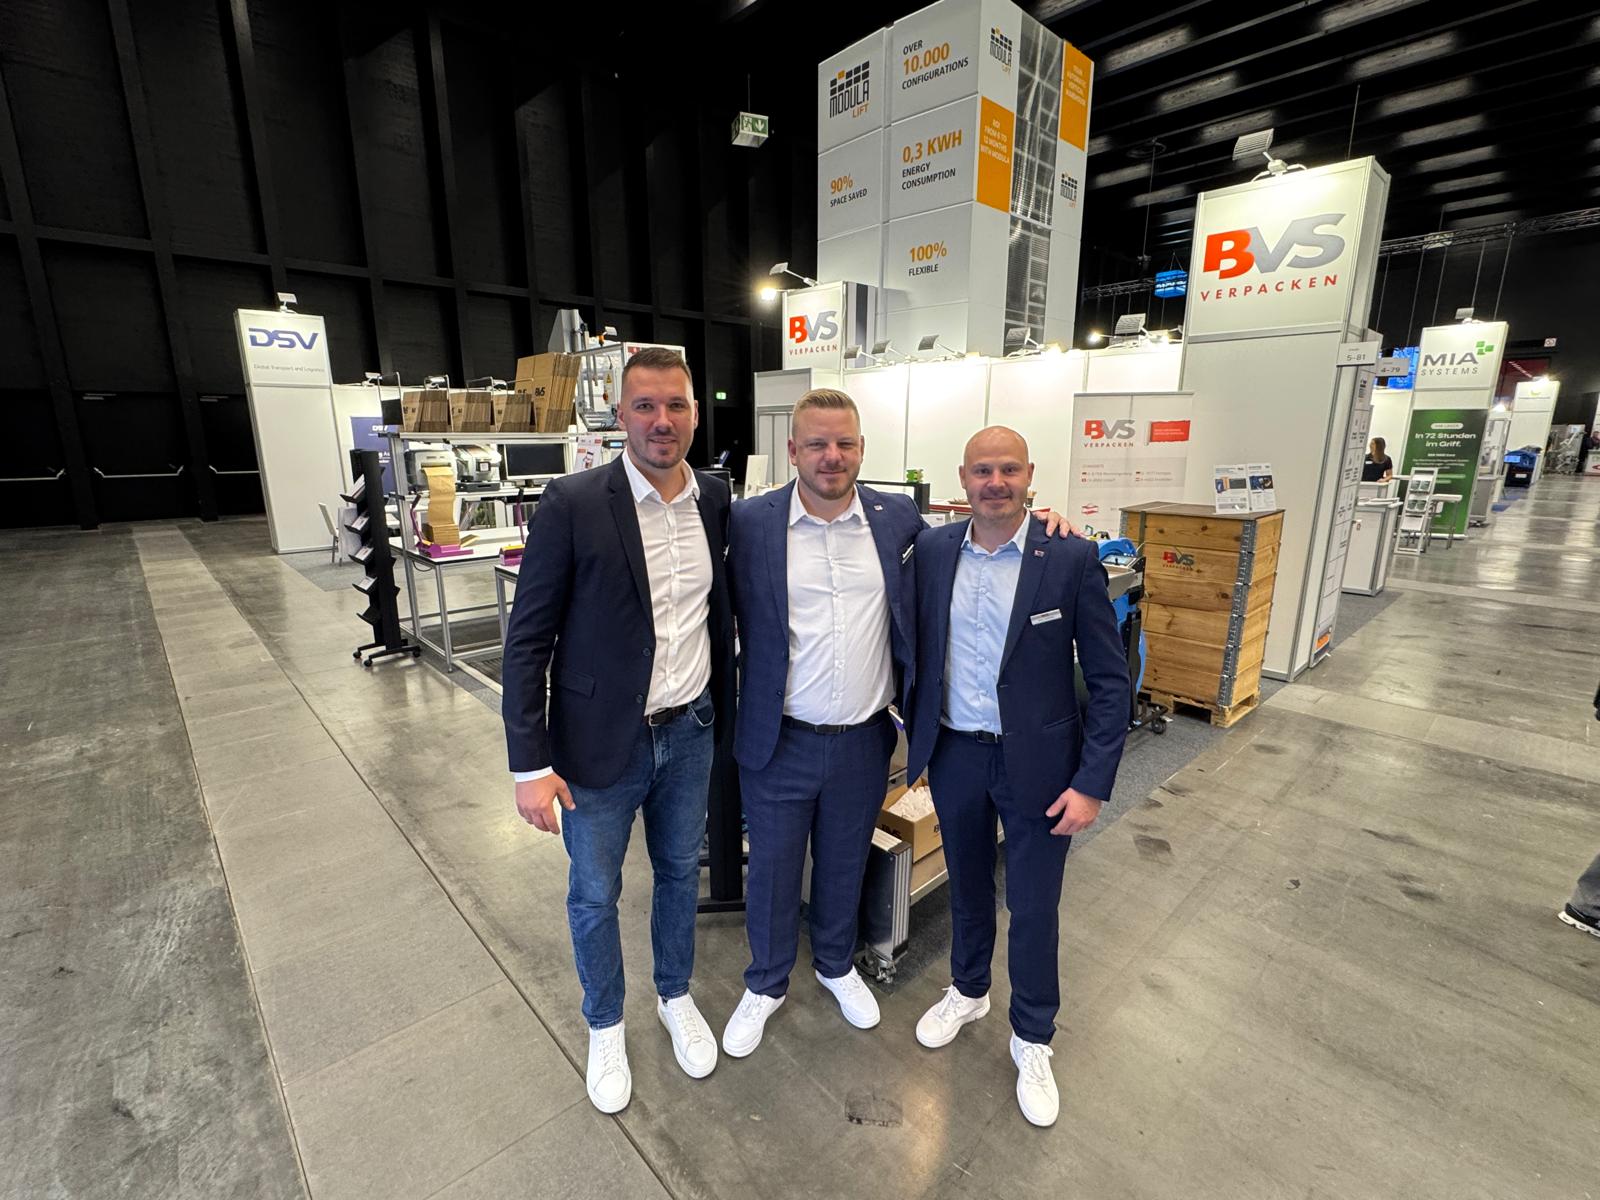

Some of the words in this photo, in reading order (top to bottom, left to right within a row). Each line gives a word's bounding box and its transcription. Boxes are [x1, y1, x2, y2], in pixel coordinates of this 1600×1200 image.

[903, 39, 923, 56] OVER
[903, 42, 950, 76] 10.000
[901, 56, 969, 90] CONFIGURATIONS
[829, 80, 870, 119] MODULA
[852, 103, 869, 118] LIFT
[902, 142, 923, 163] 0,3
[927, 129, 962, 156] KWH
[901, 168, 956, 191] CONSUMPTION
[902, 162, 931, 178] ENERGY
[831, 173, 854, 195] 90%
[830, 194, 847, 208] SPACE
[848, 188, 868, 202] SAVED
[909, 240, 947, 263] 100%
[1203, 213, 1346, 280] BVS
[908, 263, 939, 277] FLEXIBLE
[1200, 274, 1338, 302] VERPACKEN
[789, 310, 839, 344] BVS
[248, 327, 319, 350] DSV
[789, 344, 838, 356] VERPACKEN
[1423, 352, 1479, 367] MIA
[1420, 367, 1479, 377] SYSTEMS
[1084, 420, 1136, 440] BVS
[1163, 551, 1195, 566] BVS
